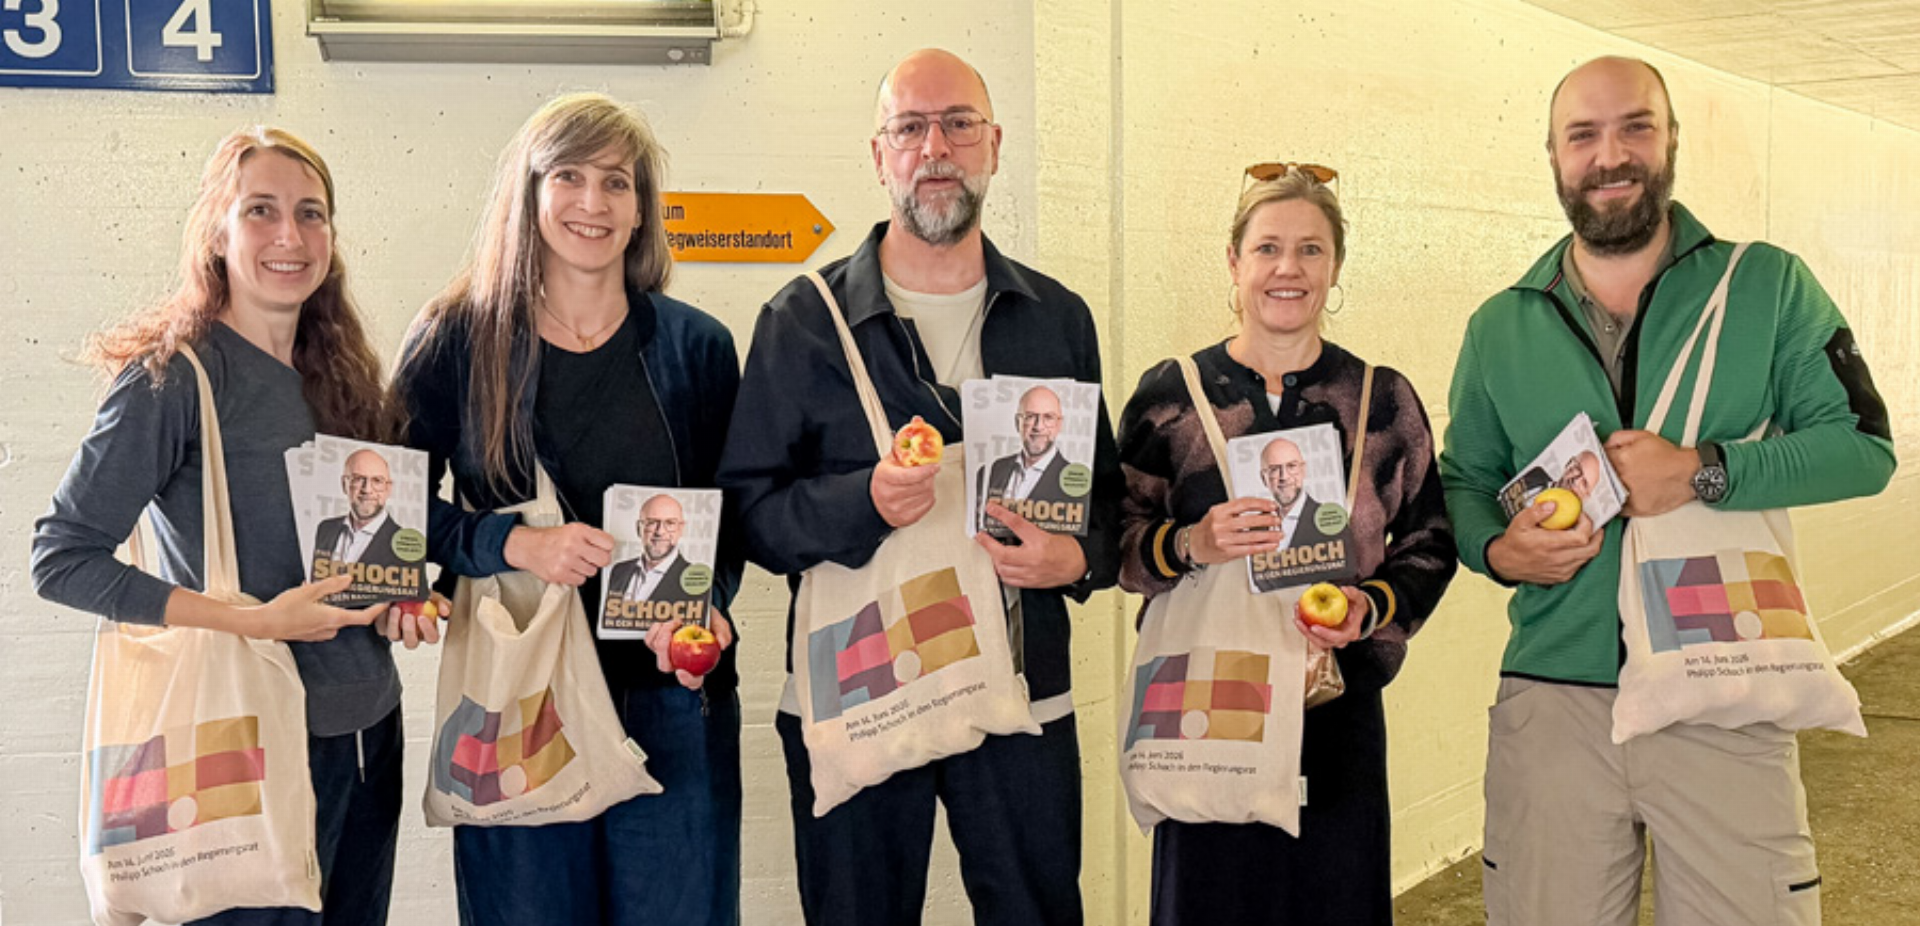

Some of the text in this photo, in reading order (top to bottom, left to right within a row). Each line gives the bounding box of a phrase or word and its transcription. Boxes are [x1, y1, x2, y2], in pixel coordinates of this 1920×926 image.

[3, 0, 222, 61] 3 4
[662, 204, 685, 220] um
[664, 229, 793, 250] egweiserstandort
[995, 381, 1092, 410] SRK
[320, 440, 424, 477] SRK
[991, 434, 1090, 465] TEM
[1236, 428, 1332, 463] SRK
[317, 494, 422, 529] TEM
[617, 490, 715, 514] SRK
[1253, 539, 1345, 572] SCHOCH
[314, 558, 420, 588] SCHOCH
[605, 598, 704, 620] SCHOCH
[1686, 668, 1716, 679] Philipp
[1716, 666, 1745, 677] Schoch
[846, 720, 860, 731] Am
[850, 727, 878, 742] Philipp
[878, 714, 907, 732] Schoch
[1164, 751, 1184, 760] 2026
[110, 871, 140, 883] Philipp
